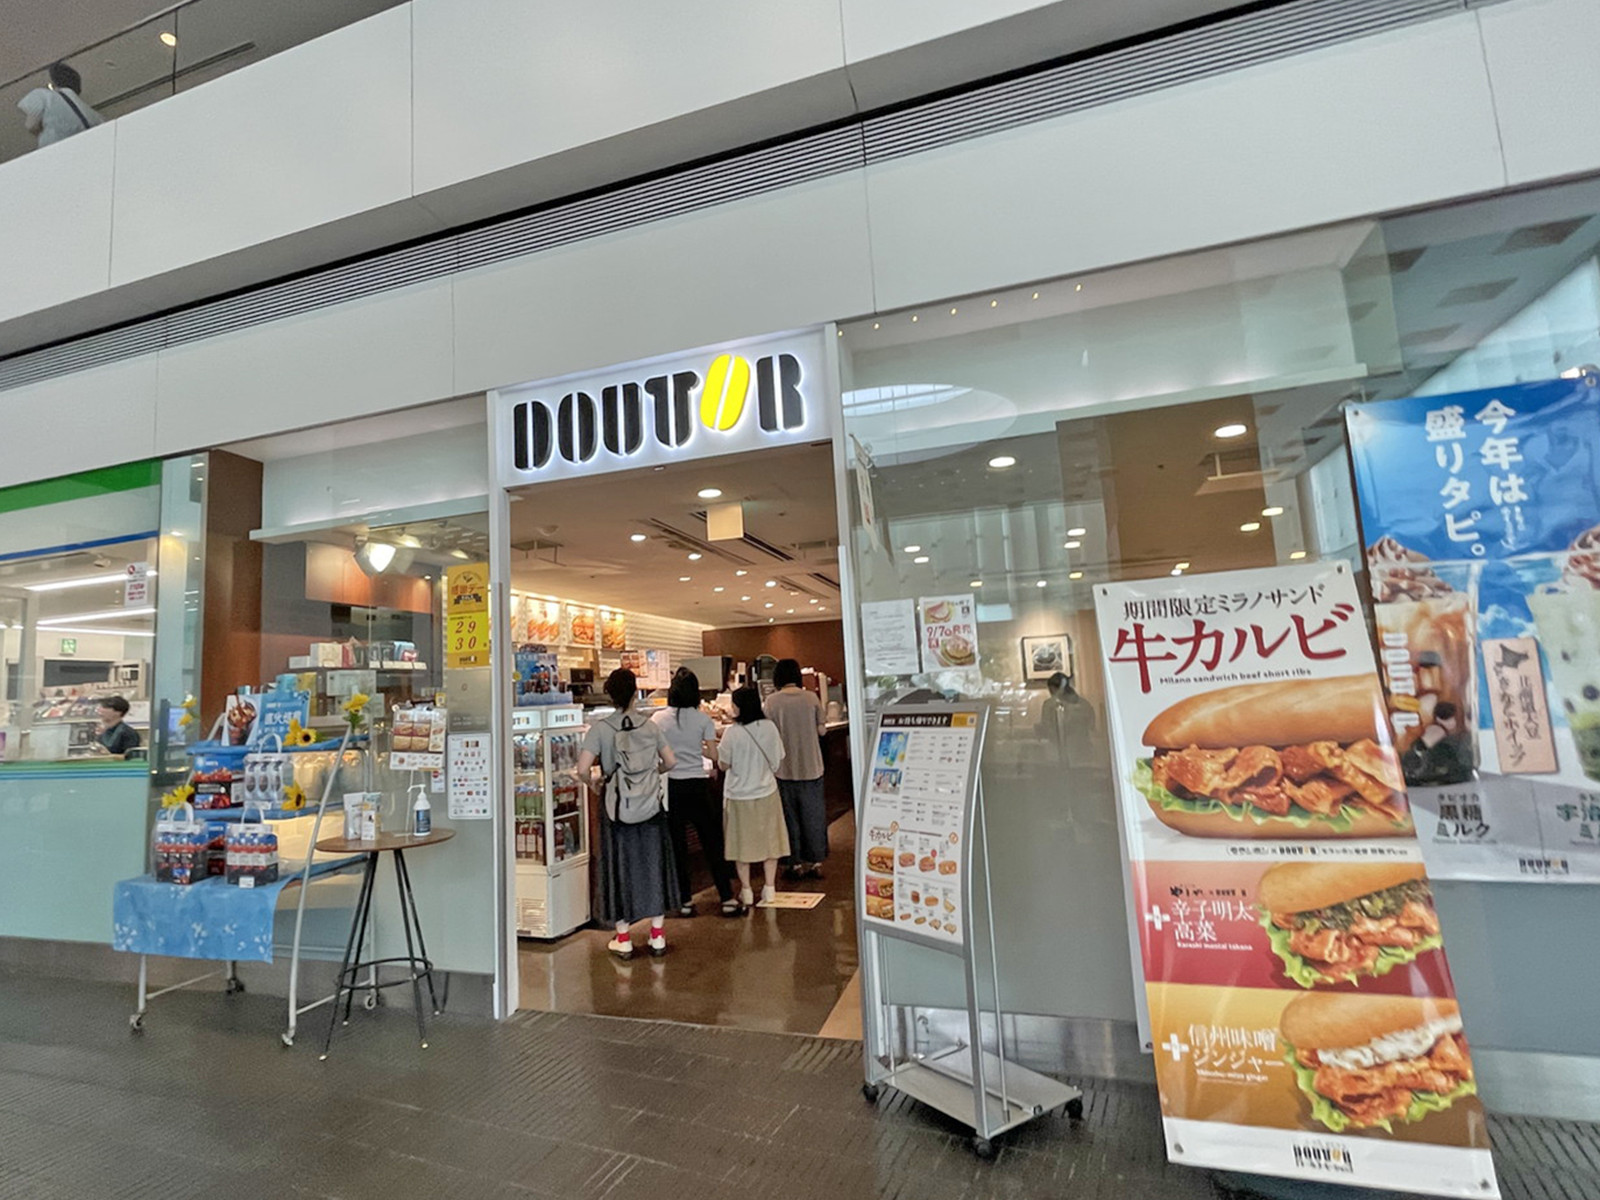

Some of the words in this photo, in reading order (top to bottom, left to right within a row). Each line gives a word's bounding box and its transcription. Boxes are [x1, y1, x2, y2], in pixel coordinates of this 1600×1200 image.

[513, 353, 805, 470] DOUTOR
[1425, 404, 1485, 556] 盛りタピ。
[1475, 399, 1528, 506] 今年は
[1124, 584, 1325, 621] 期間限定ミラノサンド
[1109, 603, 1355, 694] 牛カルビ
[1172, 899, 1255, 922] 辛子明太
[1173, 920, 1217, 942] 高菜
[1193, 1047, 1285, 1073] ジンジャー
